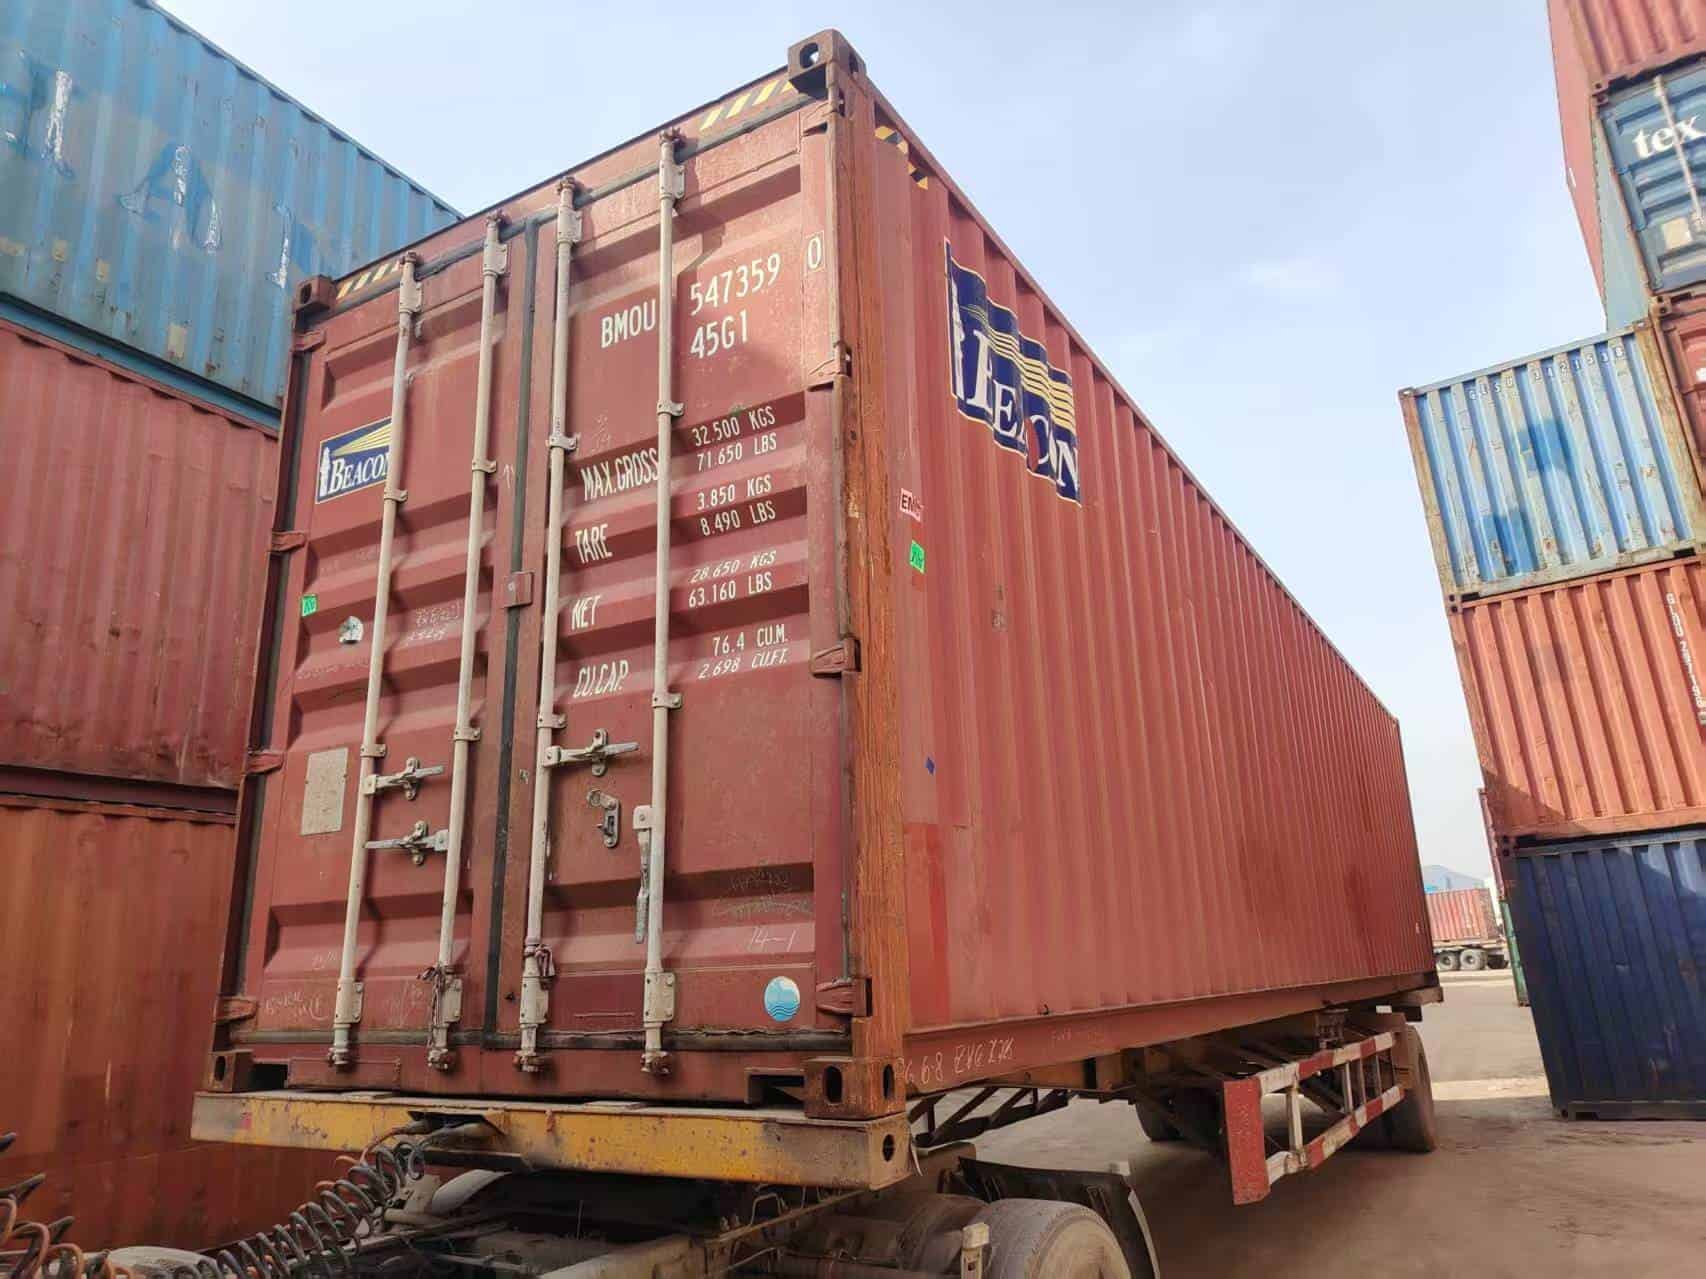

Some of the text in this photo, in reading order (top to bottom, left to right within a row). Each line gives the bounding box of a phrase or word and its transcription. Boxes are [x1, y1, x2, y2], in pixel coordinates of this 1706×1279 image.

[690, 234, 823, 316] 547359 0
[601, 299, 656, 349] BMOU
[690, 310, 748, 359] 45G1
[691, 405, 776, 448] 32.500 KGS
[697, 432, 777, 473] 71.650 LBS
[581, 448, 660, 501] MAX.GROSS
[697, 474, 772, 511] 3.850 KGS
[700, 500, 776, 537] 8.490 LBS
[575, 523, 613, 564] TARE
[688, 550, 776, 584] 28.650 KGS
[688, 571, 772, 609] 63.160 LBS
[571, 595, 601, 630] NET
[712, 632, 745, 657] 76.4
[698, 657, 741, 680] 2.698
